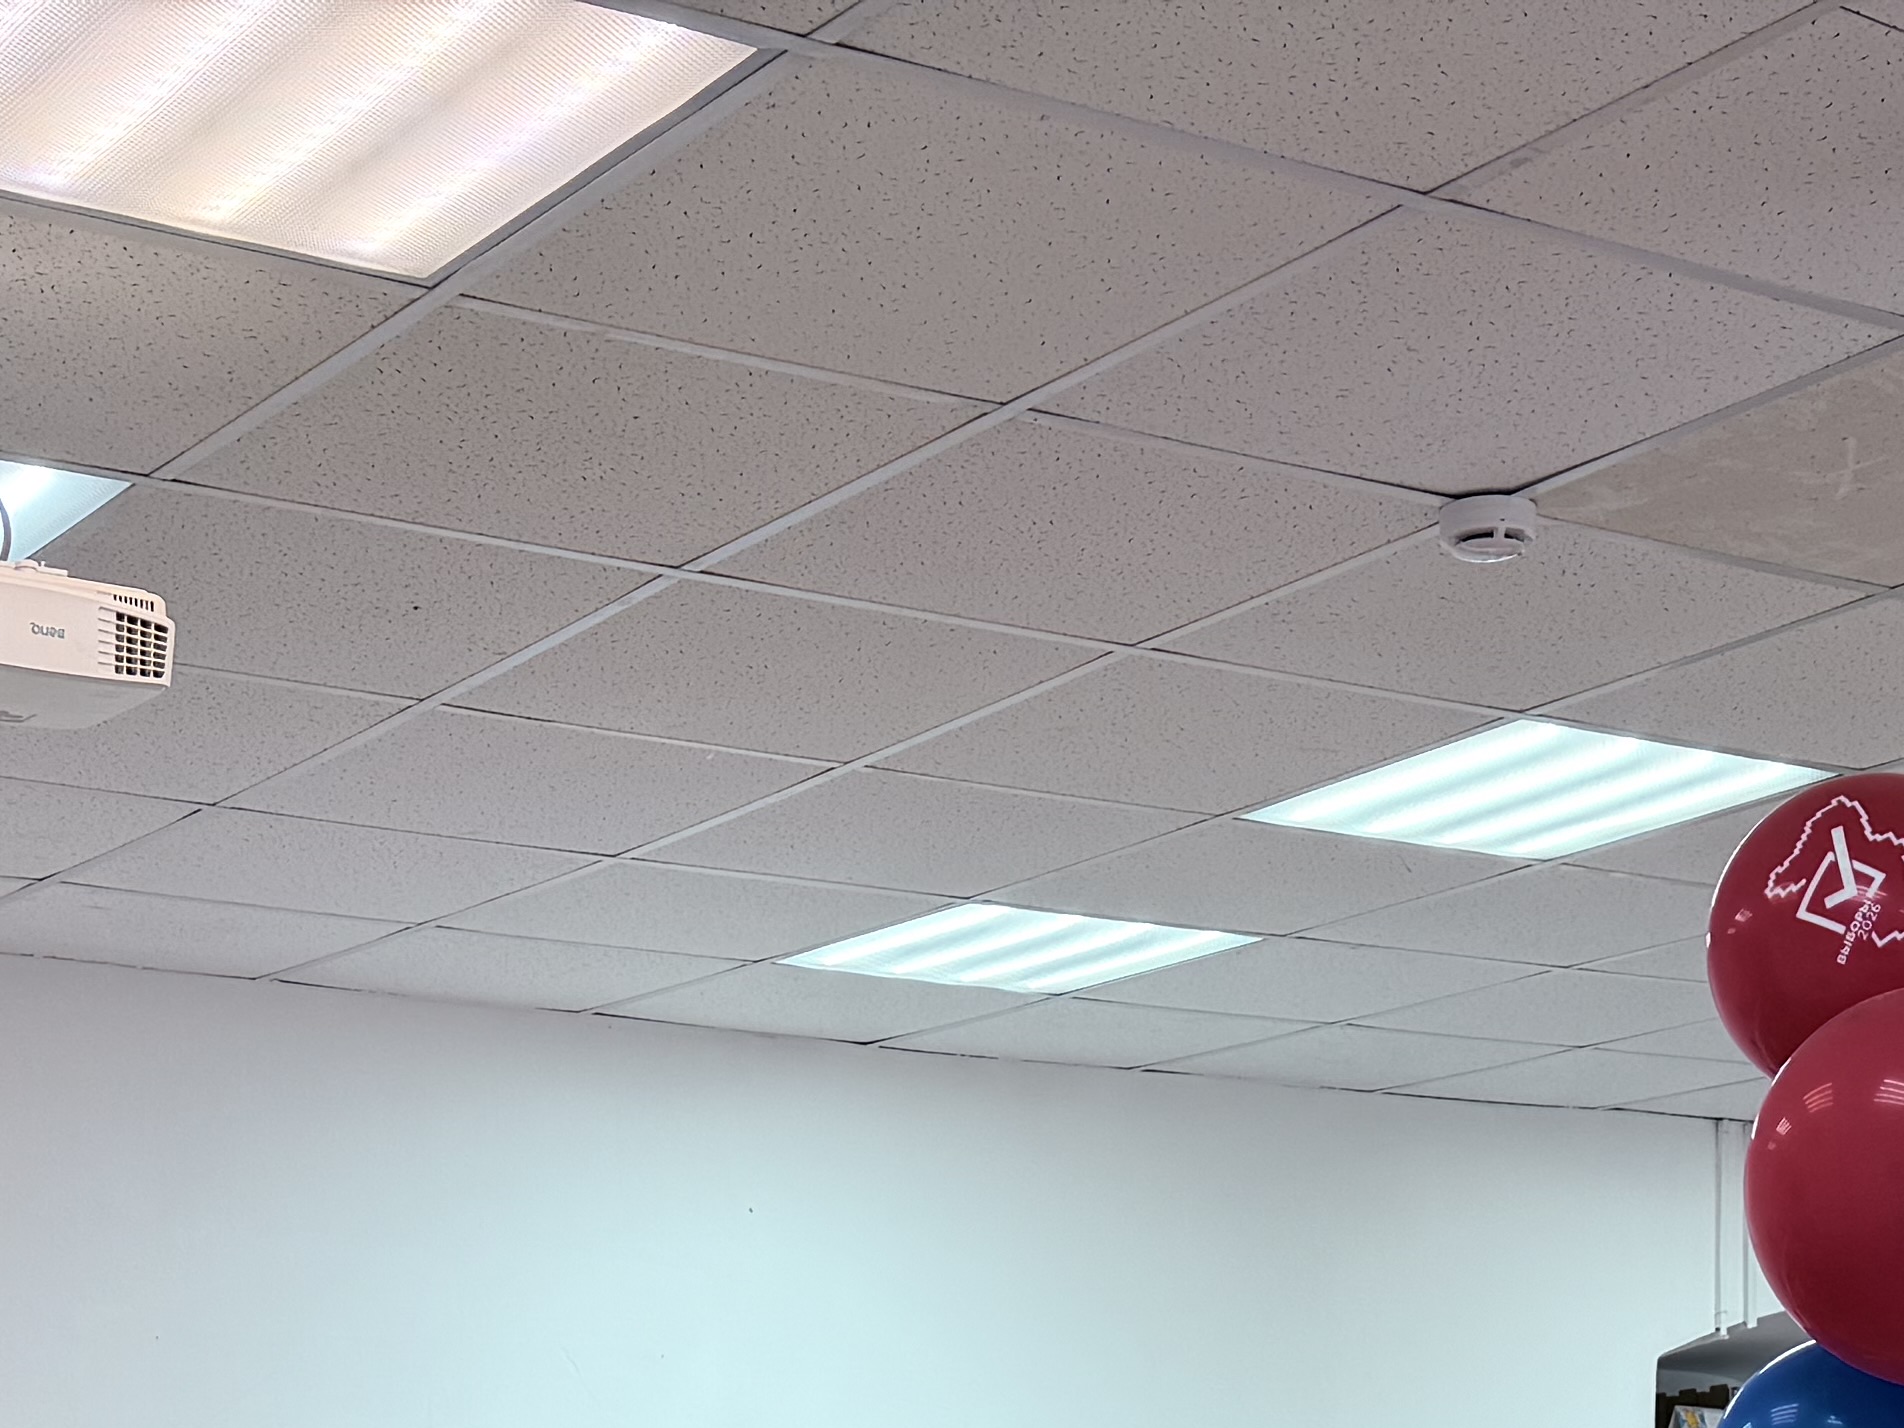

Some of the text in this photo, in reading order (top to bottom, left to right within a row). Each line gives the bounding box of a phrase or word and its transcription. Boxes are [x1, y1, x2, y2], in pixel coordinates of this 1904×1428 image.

[30, 622, 65, 639] BenQ
[1837, 900, 1871, 965] ВЫБОРЫ
[1858, 903, 1881, 940] 2026
